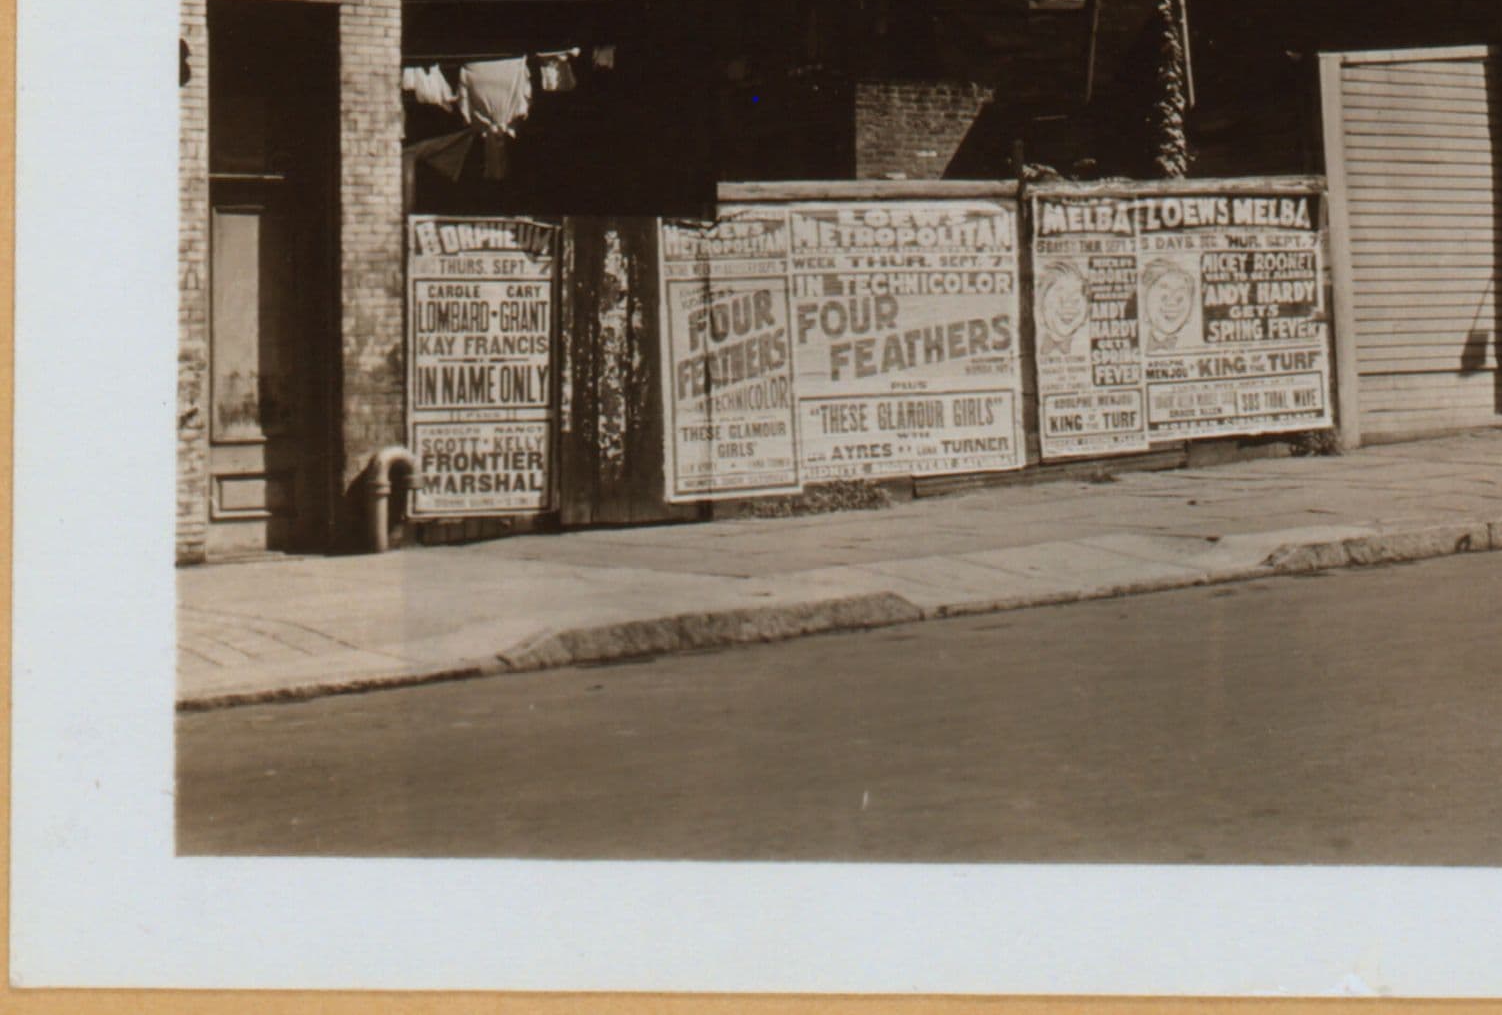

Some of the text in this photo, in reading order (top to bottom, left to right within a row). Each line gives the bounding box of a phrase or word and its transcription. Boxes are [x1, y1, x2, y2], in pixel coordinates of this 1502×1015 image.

[1042, 201, 1132, 235] MELBA
[1232, 197, 1312, 229] MELBA
[791, 213, 1013, 249] METROPOLITAN
[428, 284, 541, 298] CAROLE CARY
[796, 272, 1012, 297] IN TECHNICOLOR
[1205, 281, 1314, 305] ANDY HARDY
[418, 300, 548, 333] LOMBARD GRANT
[688, 289, 776, 353] FOUR
[797, 296, 899, 345] FOUR
[1091, 301, 1127, 319] ANDY
[1229, 305, 1279, 319] GETS
[1089, 320, 1138, 337] HARDY
[1267, 318, 1320, 340] FEVER
[419, 335, 548, 356] KAY FRANCIS
[829, 315, 1012, 382] FEATHERS
[677, 327, 787, 402] FEATHERS
[1197, 356, 1247, 378] KING
[1266, 352, 1322, 373] TURF
[417, 365, 549, 405] IN NAME ONLY
[876, 400, 945, 431] GLAMOUR
[1049, 415, 1083, 432] KING
[1102, 411, 1137, 429] TURF
[421, 436, 543, 454] SCOTT KELLY
[831, 442, 893, 461] AYRES
[940, 436, 1009, 454] TURNER
[421, 452, 543, 473] FRONTIER
[421, 473, 543, 495] MARSHAL
